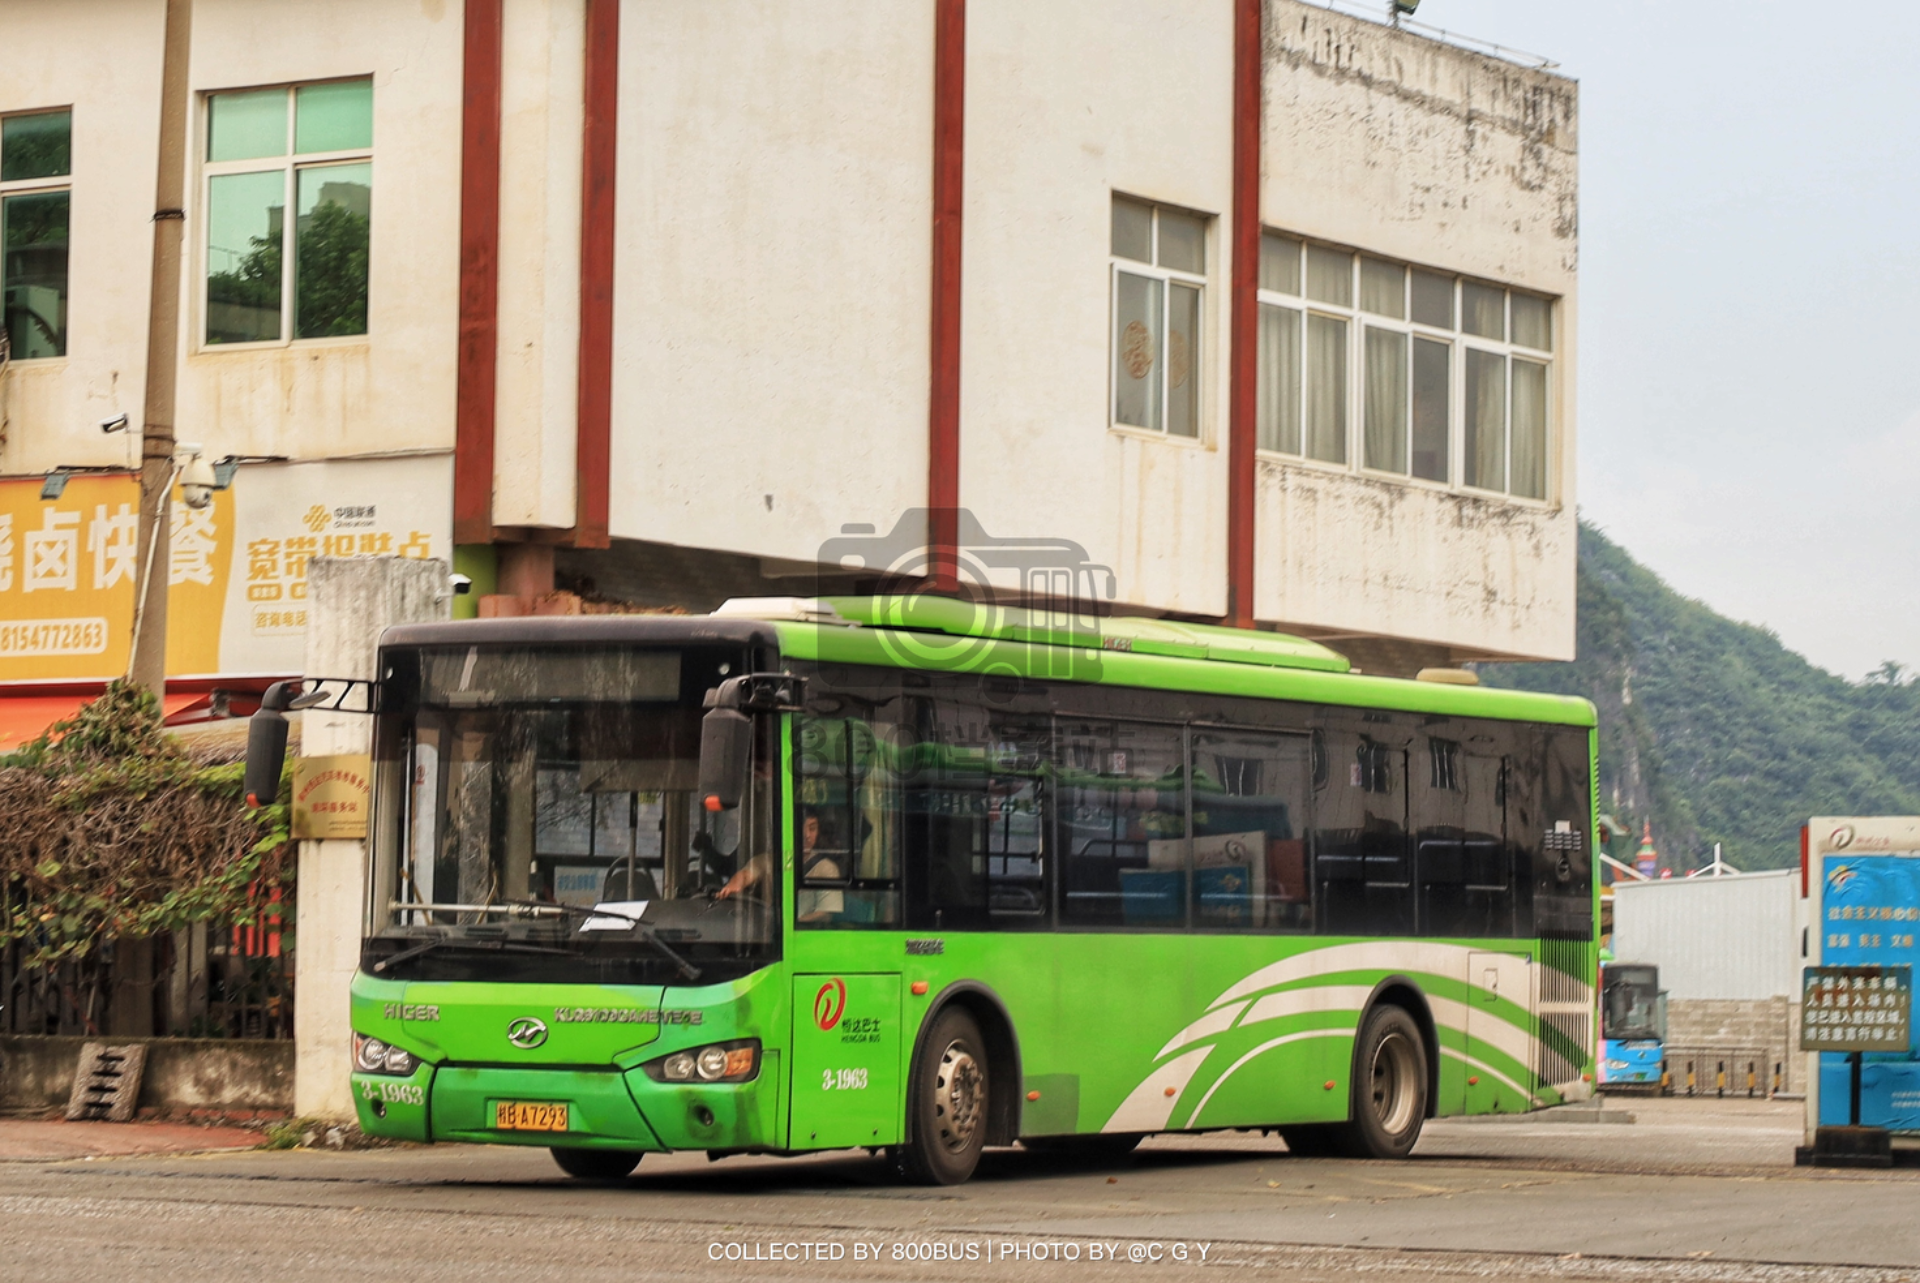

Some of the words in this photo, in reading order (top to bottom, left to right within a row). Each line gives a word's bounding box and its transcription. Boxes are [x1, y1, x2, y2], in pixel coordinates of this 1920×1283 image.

[384, 1003, 440, 1021] HIGER
[822, 1068, 868, 1090] 3-1963
[361, 1080, 425, 1106] 3-1963
